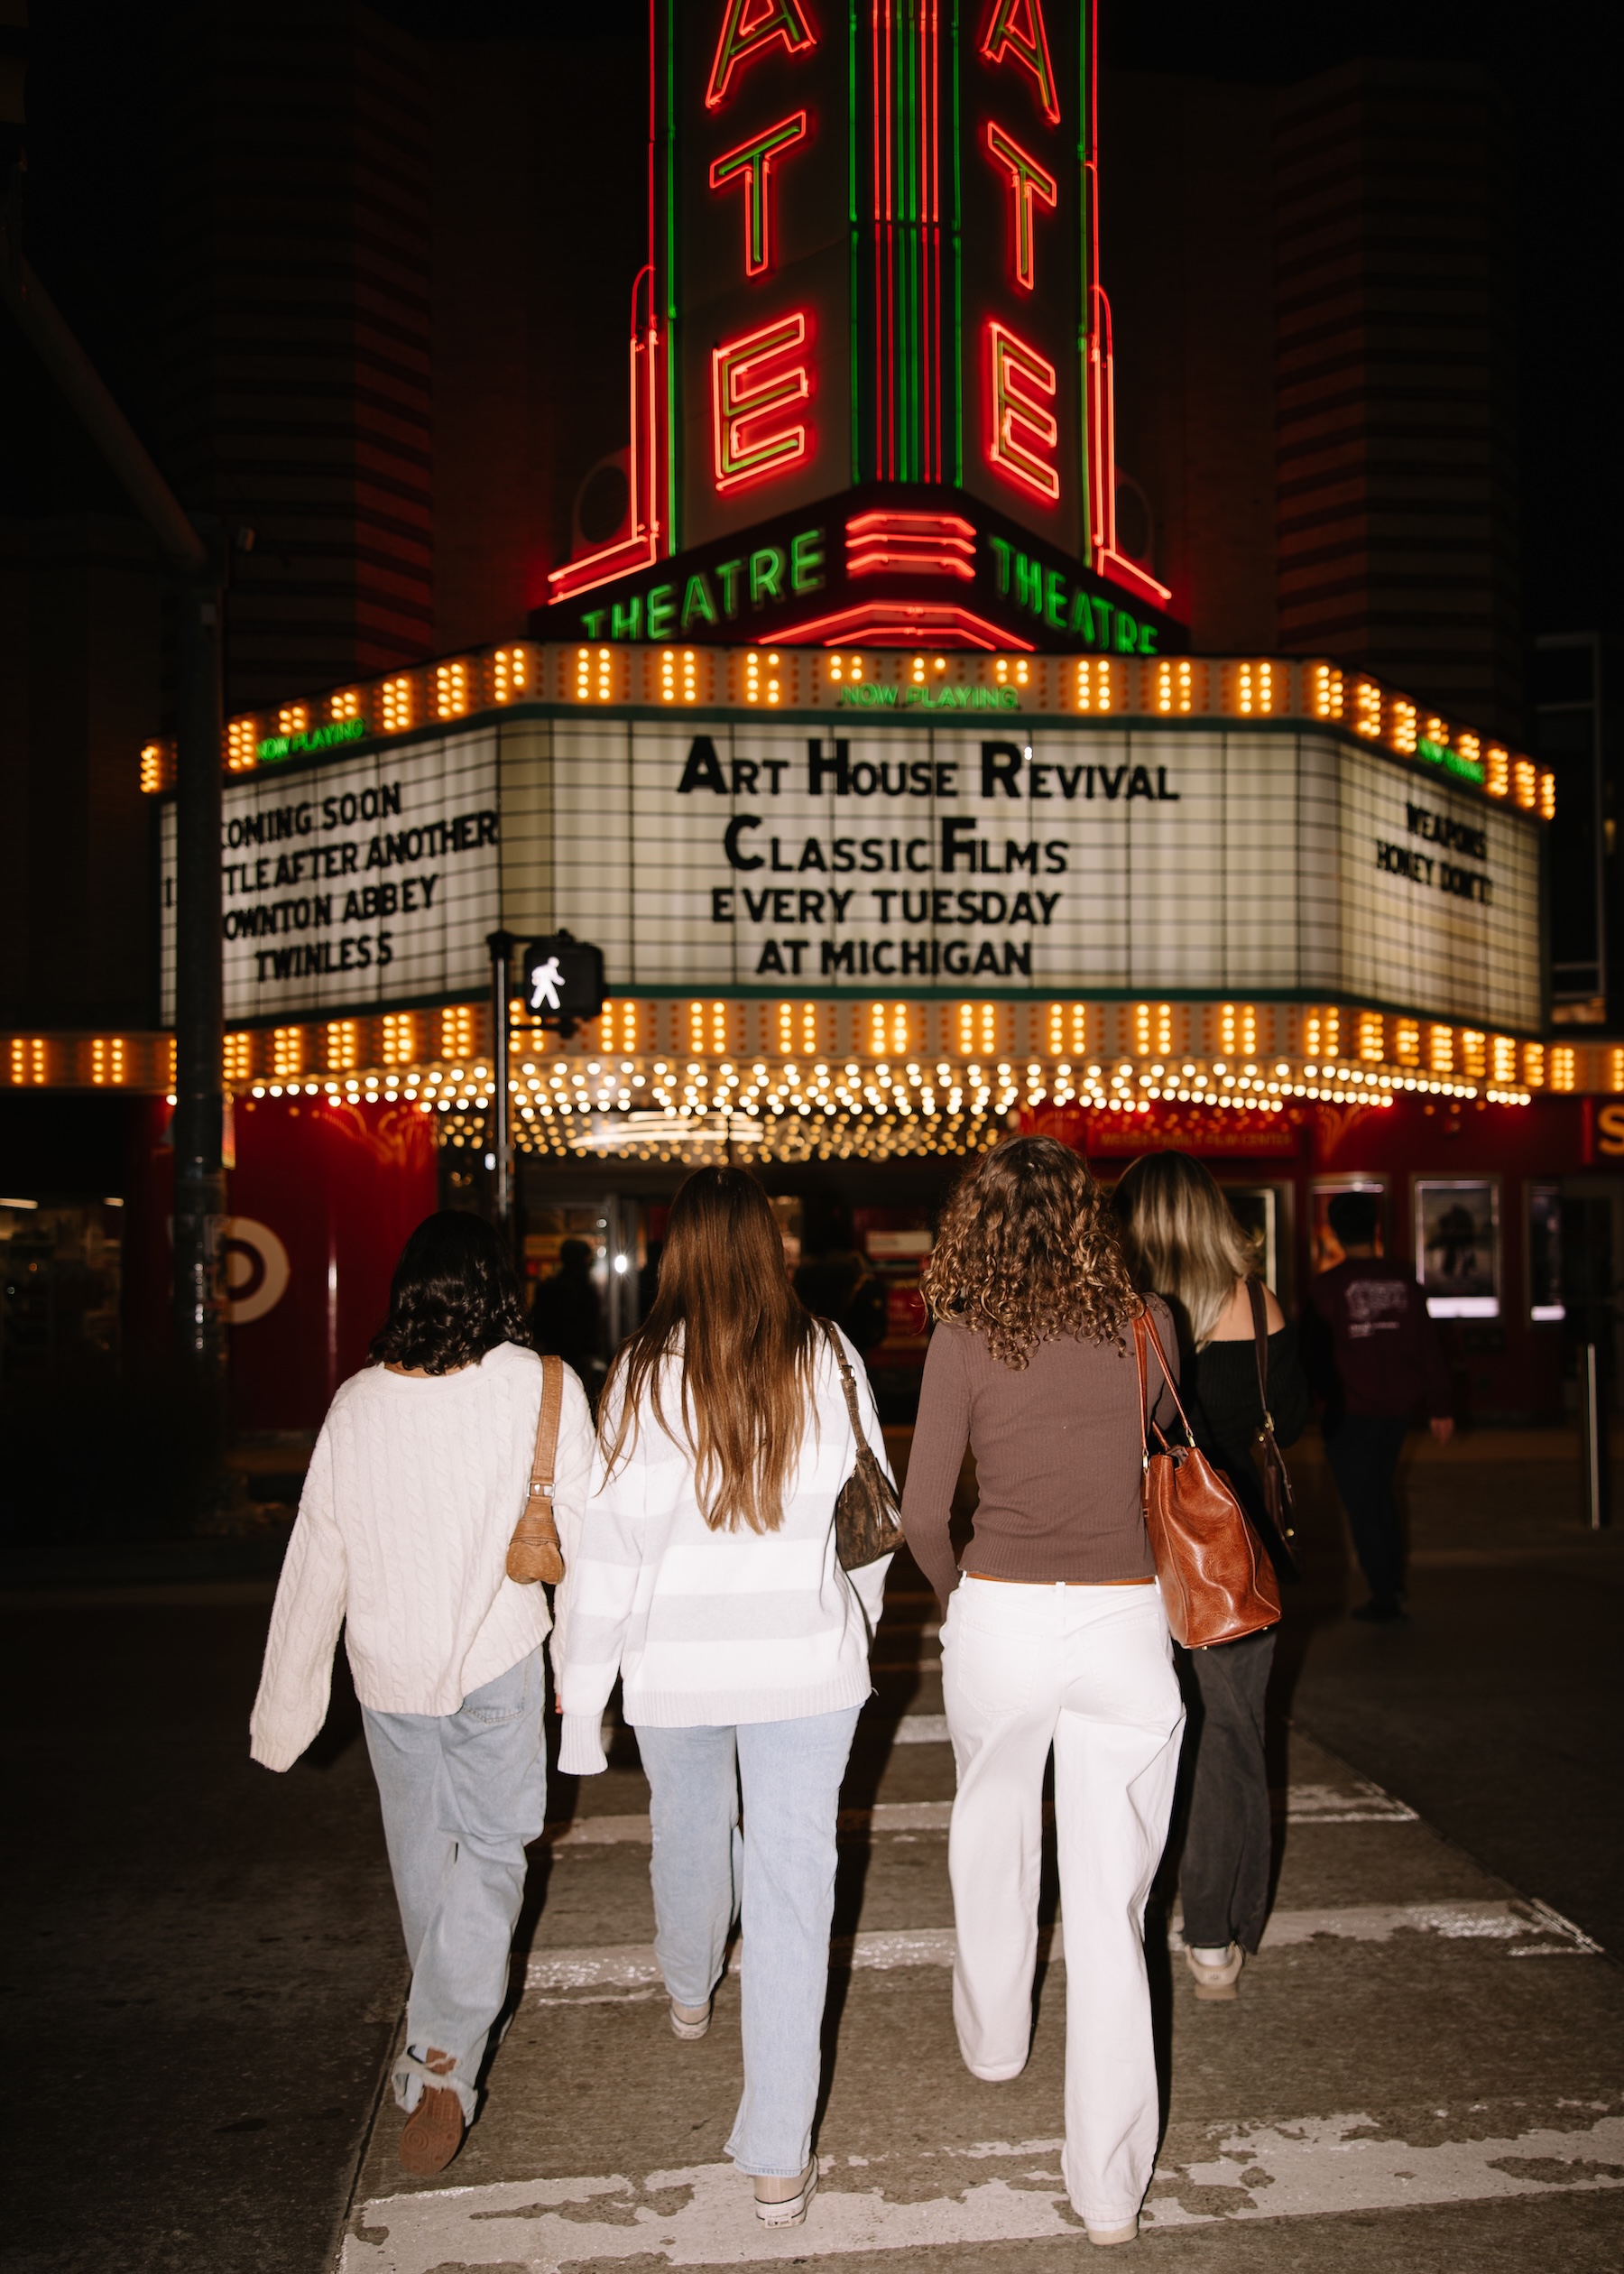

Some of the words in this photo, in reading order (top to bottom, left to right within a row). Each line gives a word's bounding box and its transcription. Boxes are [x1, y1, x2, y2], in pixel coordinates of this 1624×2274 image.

[580, 528, 823, 641] THEATRE
[991, 536, 1158, 655] THEATRE
[841, 683, 899, 706] NOW
[905, 684, 1019, 709] PLAYING
[257, 735, 291, 761] NOW
[291, 716, 364, 753] PLAYING
[678, 735, 789, 795] ART
[808, 737, 958, 798] HOUSE
[981, 740, 1179, 801] REVIVAL
[222, 801, 311, 849] OMING
[322, 781, 401, 831] SOON
[724, 813, 929, 873] CLASSIC
[942, 817, 1069, 874] FILMS
[223, 858, 269, 895] TLE
[274, 842, 358, 887] AFTER
[365, 809, 498, 871] ANOTHER
[1377, 839, 1434, 886] HONEY
[223, 892, 332, 939] OWNTON
[343, 874, 438, 923] ABBEY
[712, 887, 855, 923] EVERY
[872, 889, 1061, 925] TUESDAY
[255, 931, 393, 982] TWINLESS
[756, 938, 810, 975] AT
[821, 939, 1031, 975] MICHIGAN
